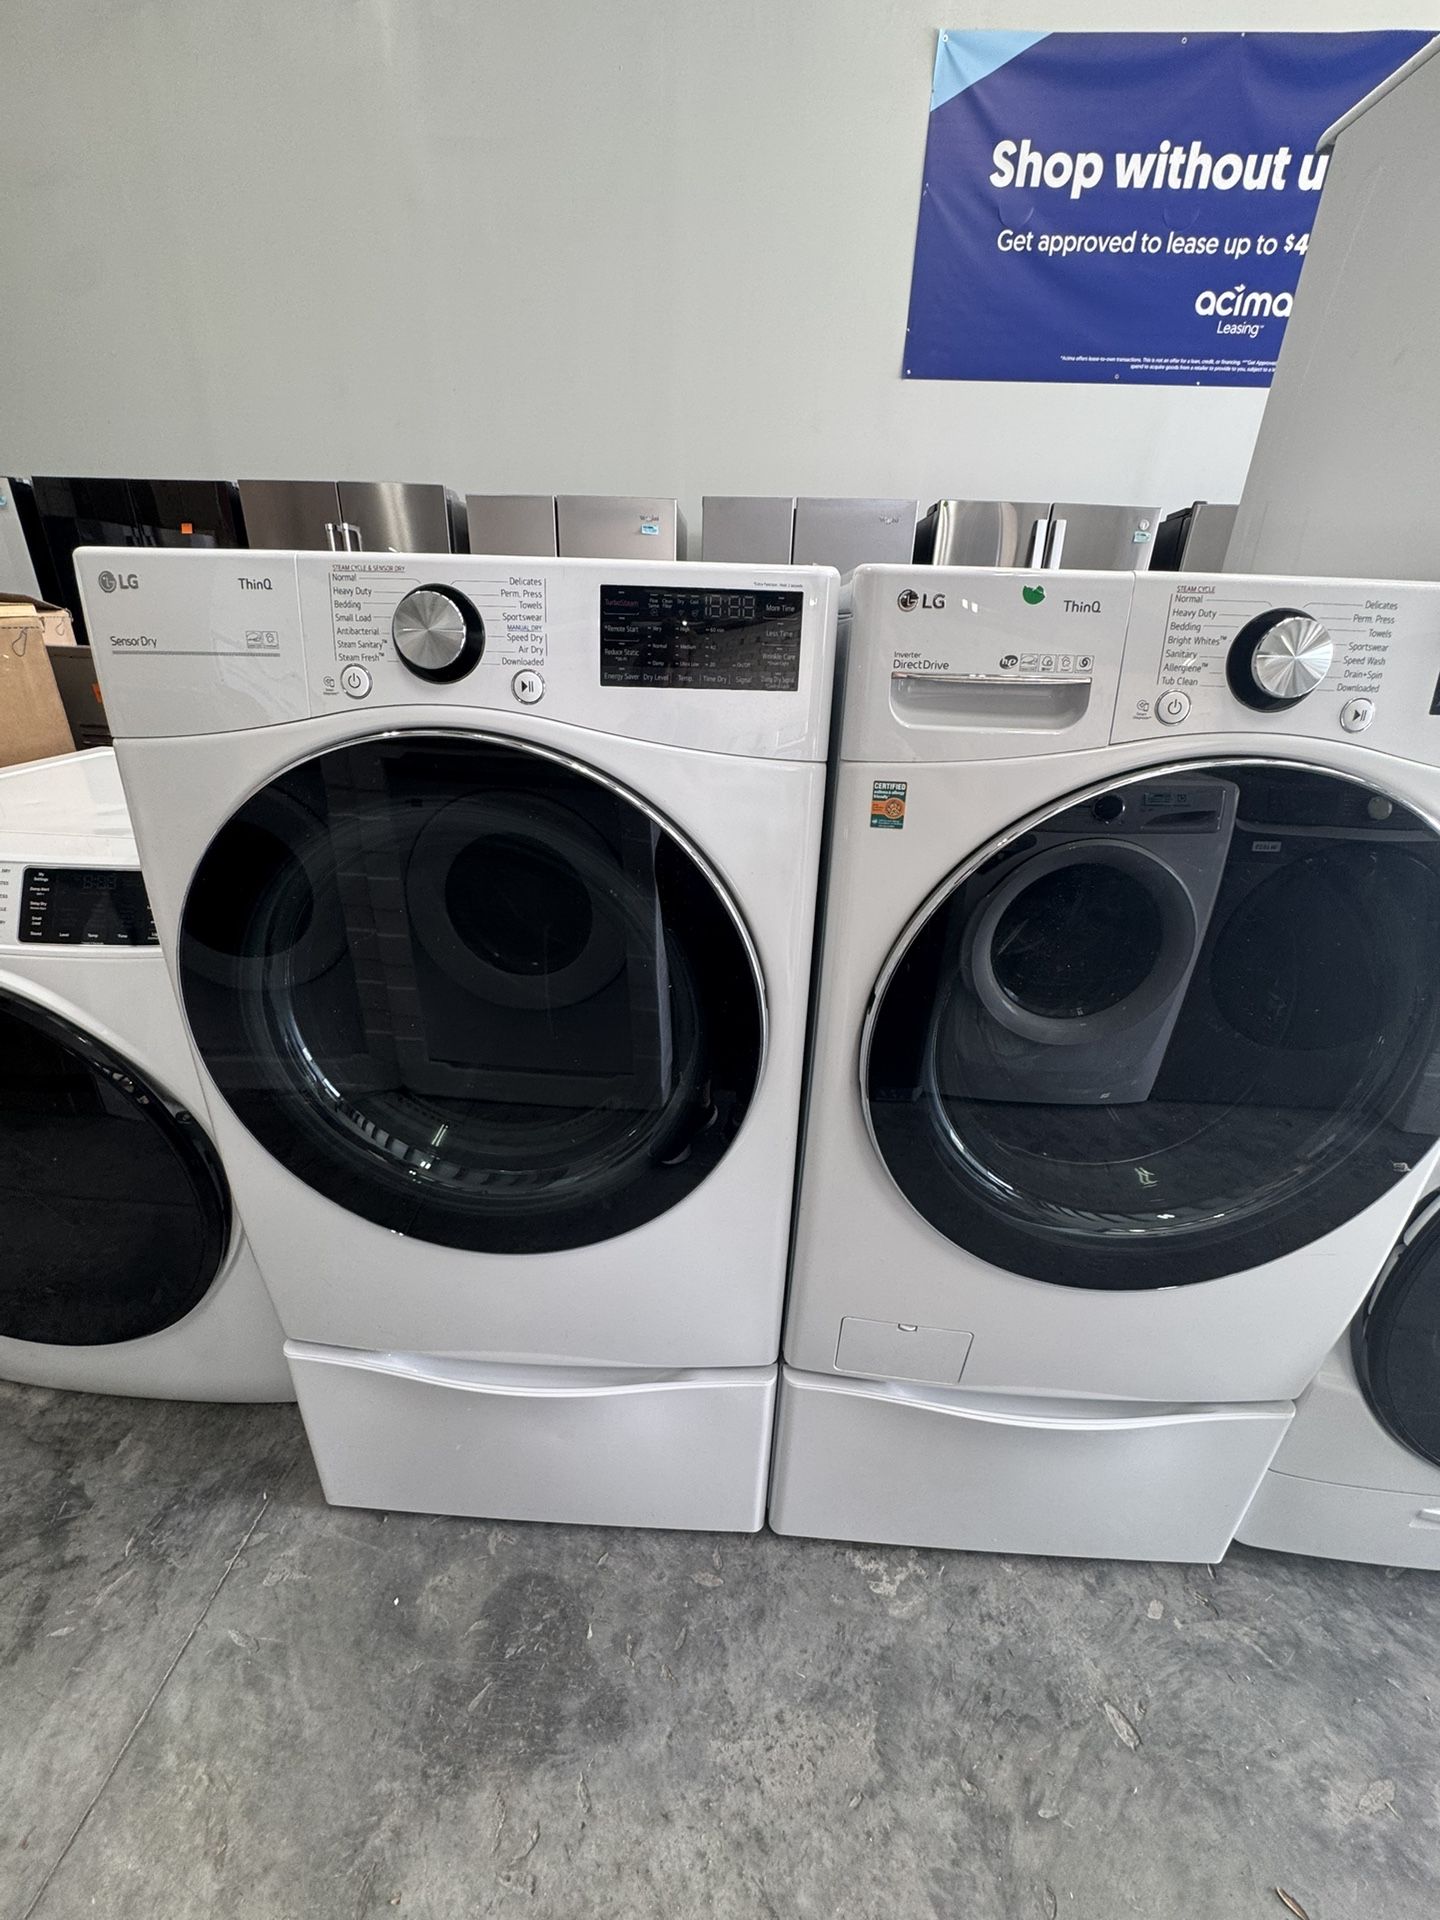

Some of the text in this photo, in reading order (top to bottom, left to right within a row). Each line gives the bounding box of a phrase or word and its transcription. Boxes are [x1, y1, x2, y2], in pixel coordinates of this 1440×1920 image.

[990, 140, 1330, 199] Shop without u
[997, 229, 1310, 260] Get approved to lease up to $4
[1195, 283, 1294, 318] acima
[119, 574, 139, 590] LG
[332, 573, 356, 581] Normal
[509, 576, 542, 586] Delicates
[238, 578, 273, 590] ThinQ
[332, 586, 372, 597] Heavy Duty
[500, 589, 542, 598] Perm. Press
[1176, 586, 1216, 594] STEAM CYCLE
[922, 594, 946, 609] LG
[1175, 594, 1204, 603] Normal
[334, 600, 362, 611] Bedding
[519, 600, 542, 610] Towels
[782, 604, 796, 612] Time
[1064, 600, 1102, 614] ThinQ
[1364, 600, 1398, 610] Delicates
[335, 613, 372, 622] Small Load
[502, 612, 542, 622] Sportswear
[1172, 608, 1217, 620] Heavy Duty
[1353, 614, 1395, 624] Perm. Press
[336, 627, 380, 635] Antibacterial
[507, 624, 542, 632] MANUAL DRY
[1170, 622, 1202, 633] Bedding
[1368, 628, 1392, 638] Towels
[506, 633, 544, 644] Speed Dry
[1168, 636, 1192, 646] Bright
[337, 640, 356, 648] Steam
[1348, 642, 1389, 653] Sportswear
[518, 645, 544, 656] Air Dry
[1166, 649, 1198, 659] Sanitary
[338, 653, 360, 662] Steam
[502, 657, 544, 666] Downloaded
[1343, 656, 1386, 666] Speed Wash
[604, 672, 623, 680] Energy
[643, 674, 654, 682] Dry
[1344, 669, 1383, 680] Drain+Spin
[1162, 676, 1198, 686] Tub Clean
[1336, 682, 1380, 693] Downloaded
